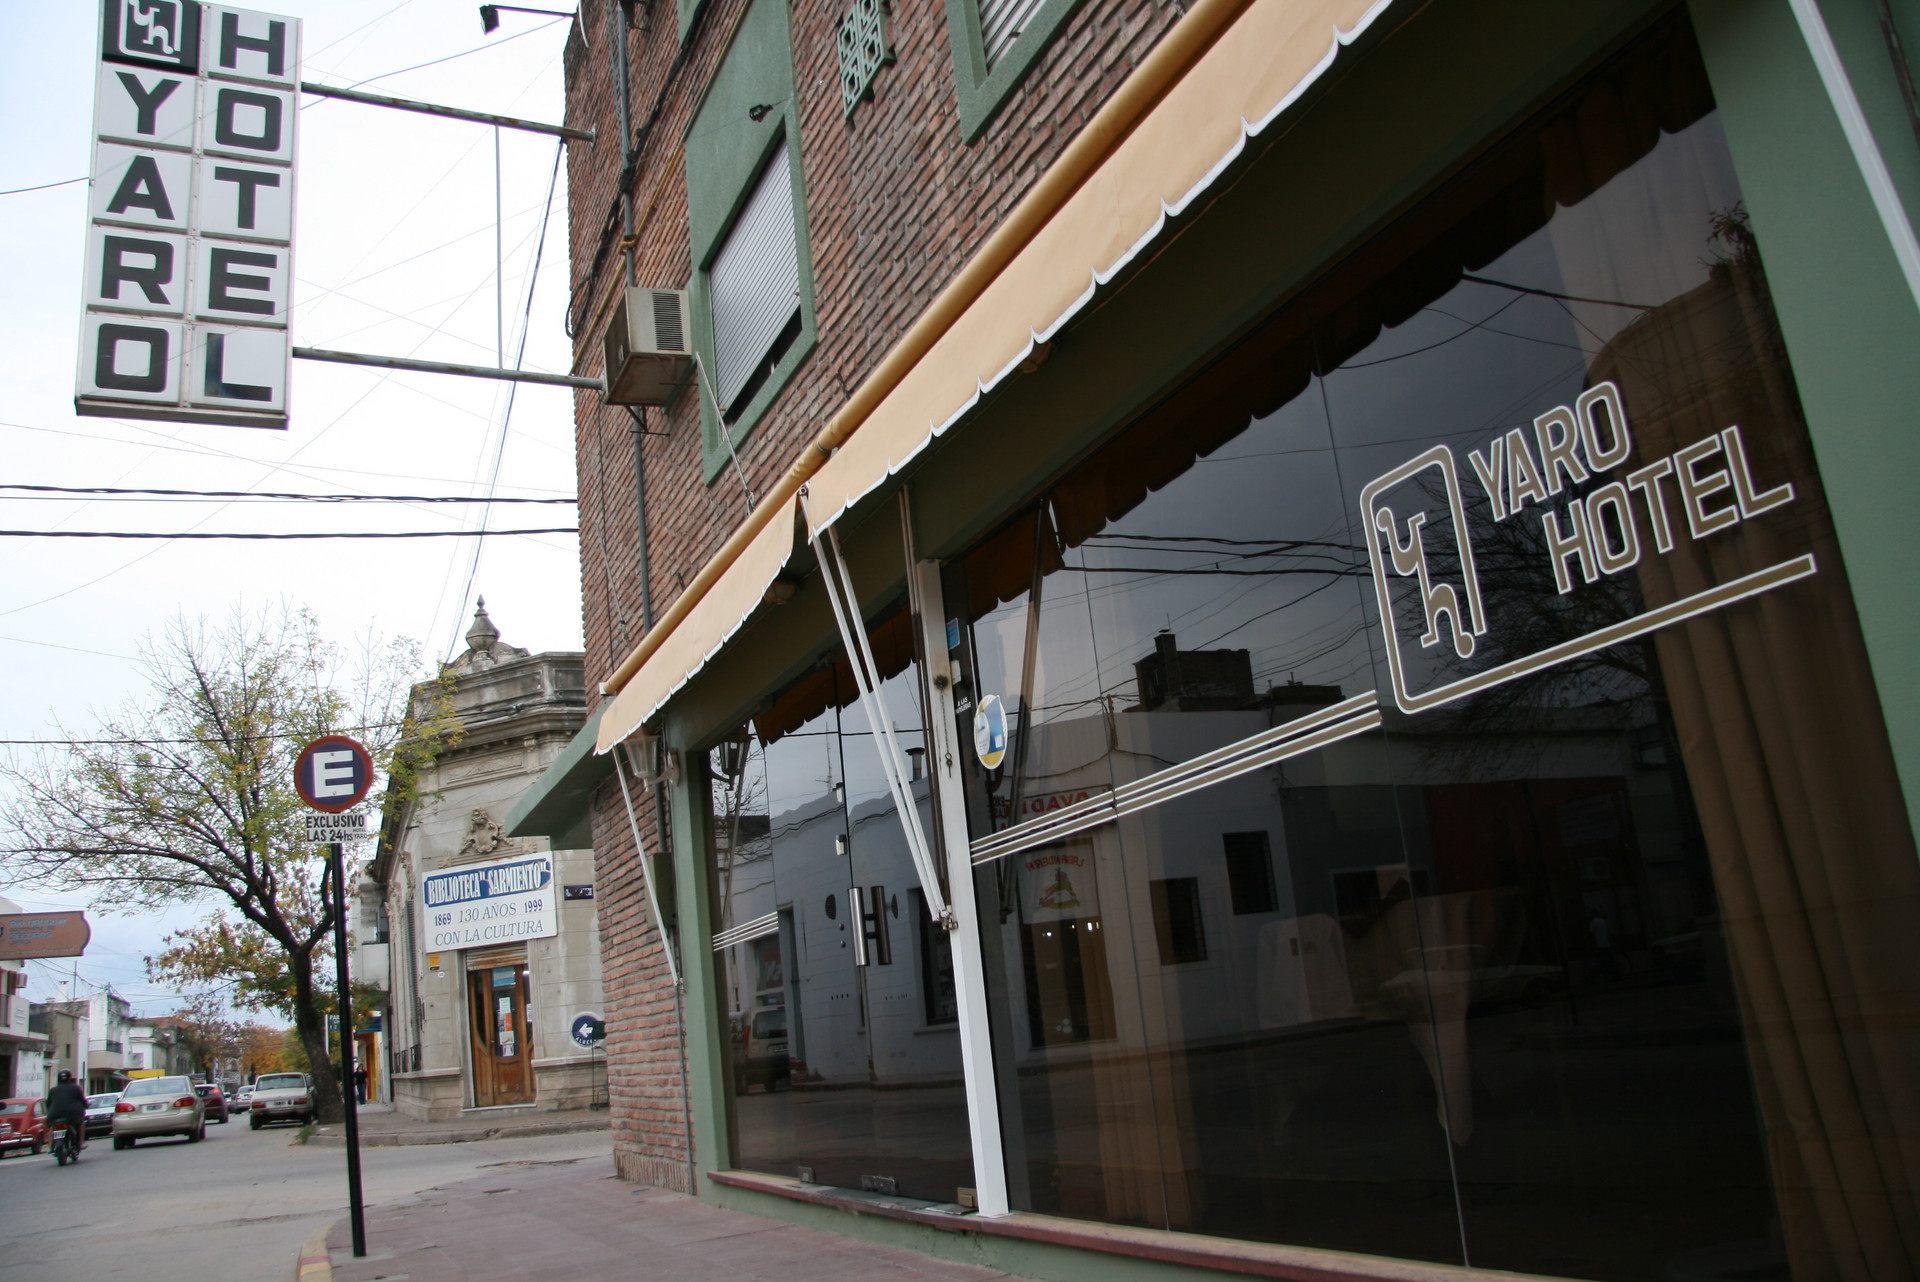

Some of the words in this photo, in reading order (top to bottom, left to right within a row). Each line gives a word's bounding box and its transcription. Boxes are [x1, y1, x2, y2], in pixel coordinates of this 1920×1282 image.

[204, 11, 286, 402] HOTEL
[95, 71, 182, 393] YARO
[1468, 380, 1630, 522] YARO
[1542, 425, 1795, 595] HOTEL
[313, 750, 354, 798] E
[306, 814, 365, 829] EXCLUSIVO
[307, 829, 327, 842] LAS
[329, 829, 353, 841] 24hs
[427, 874, 481, 905] BIBLIOTECA
[434, 912, 452, 926] 1869
[459, 908, 480, 923] 130
[482, 902, 517, 920] AÑOS
[524, 899, 543, 914] 1999
[435, 931, 461, 946] CON
[465, 929, 480, 942] LA
[484, 920, 544, 940] CULTURA
